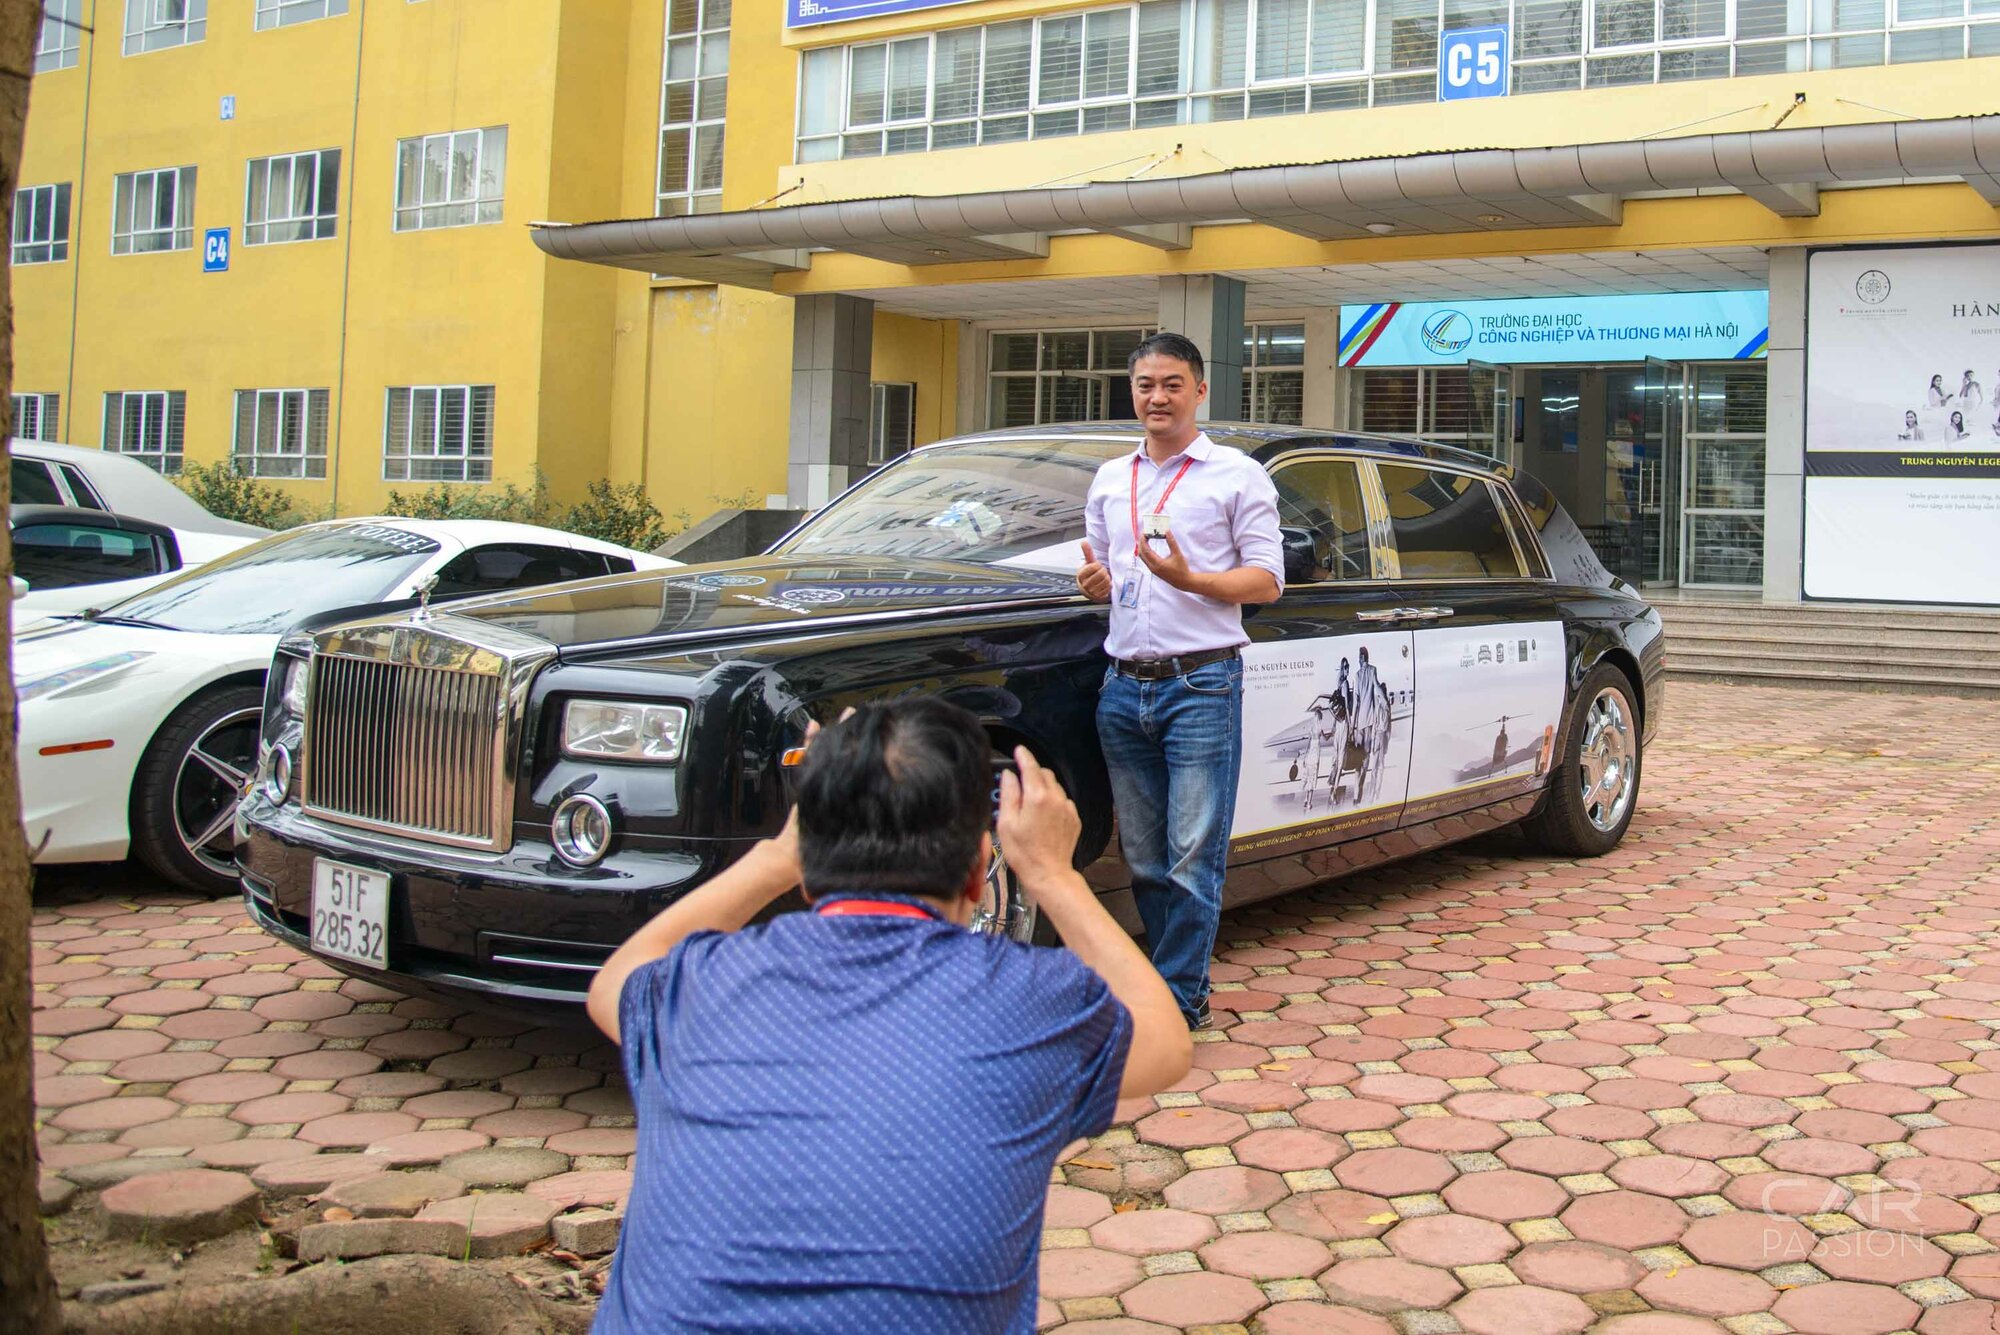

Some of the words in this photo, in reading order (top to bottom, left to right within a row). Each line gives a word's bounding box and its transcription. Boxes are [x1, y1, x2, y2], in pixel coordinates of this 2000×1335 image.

[1447, 41, 1500, 87] C5
[221, 98, 234, 119] C4
[206, 236, 227, 263] C4
[1478, 329, 1517, 343] CÔNG
[1521, 327, 1574, 344] NGHIỆP
[1577, 326, 1595, 340] VÀ
[1598, 326, 1660, 340] THƯƠNG
[1664, 326, 1690, 341] MẠI
[1695, 322, 1713, 338] HÀ
[1716, 322, 1738, 339] NỘI
[1480, 313, 1529, 328] TRƯỜNG
[1532, 314, 1552, 329] ĐẠI
[1556, 313, 1582, 328] HỌC
[1900, 457, 1934, 466] TRUNG
[1936, 456, 1976, 466] NGUYÊN
[350, 525, 439, 553] COFFEE!
[1261, 661, 1288, 671] NGUYÊN
[1290, 660, 1314, 670] LEGEND
[331, 867, 370, 912] 51F
[315, 908, 383, 961] 285.32
